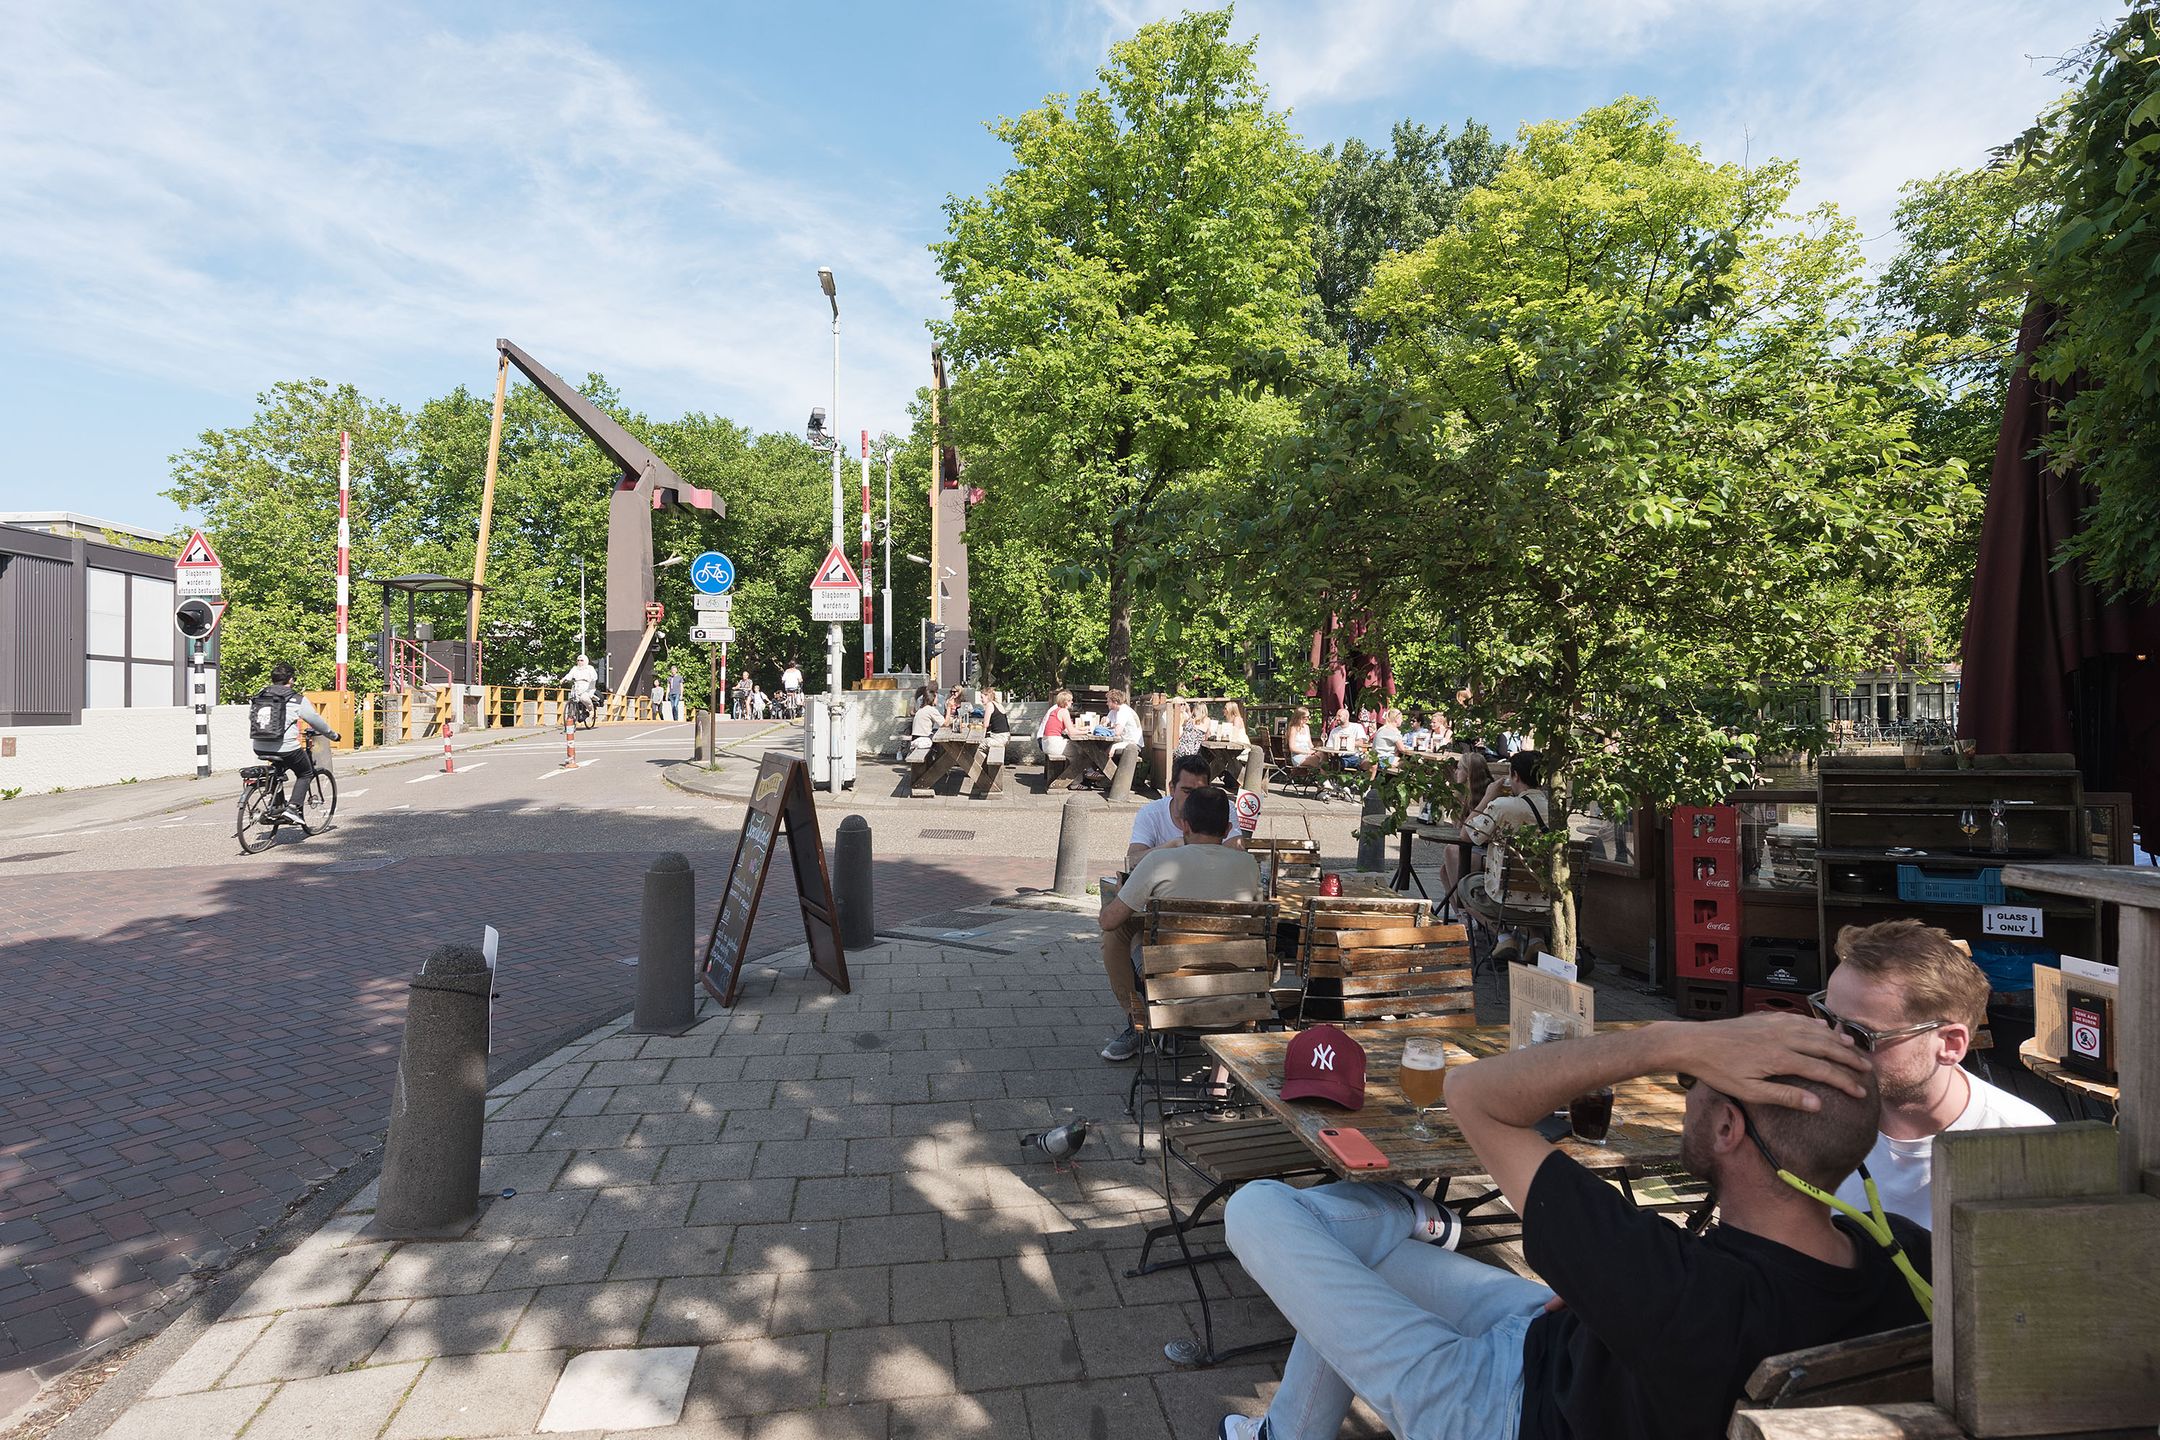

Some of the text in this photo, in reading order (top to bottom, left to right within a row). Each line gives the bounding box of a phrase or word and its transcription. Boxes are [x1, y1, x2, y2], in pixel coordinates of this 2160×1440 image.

[821, 591, 850, 600] Slagbomen
[834, 611, 859, 619] bestuurd
[1997, 912, 2028, 921] GLASS
[2000, 924, 2025, 932] ONLY
[2087, 1012, 2097, 1020] AAN
[1311, 1043, 1336, 1071] NY
